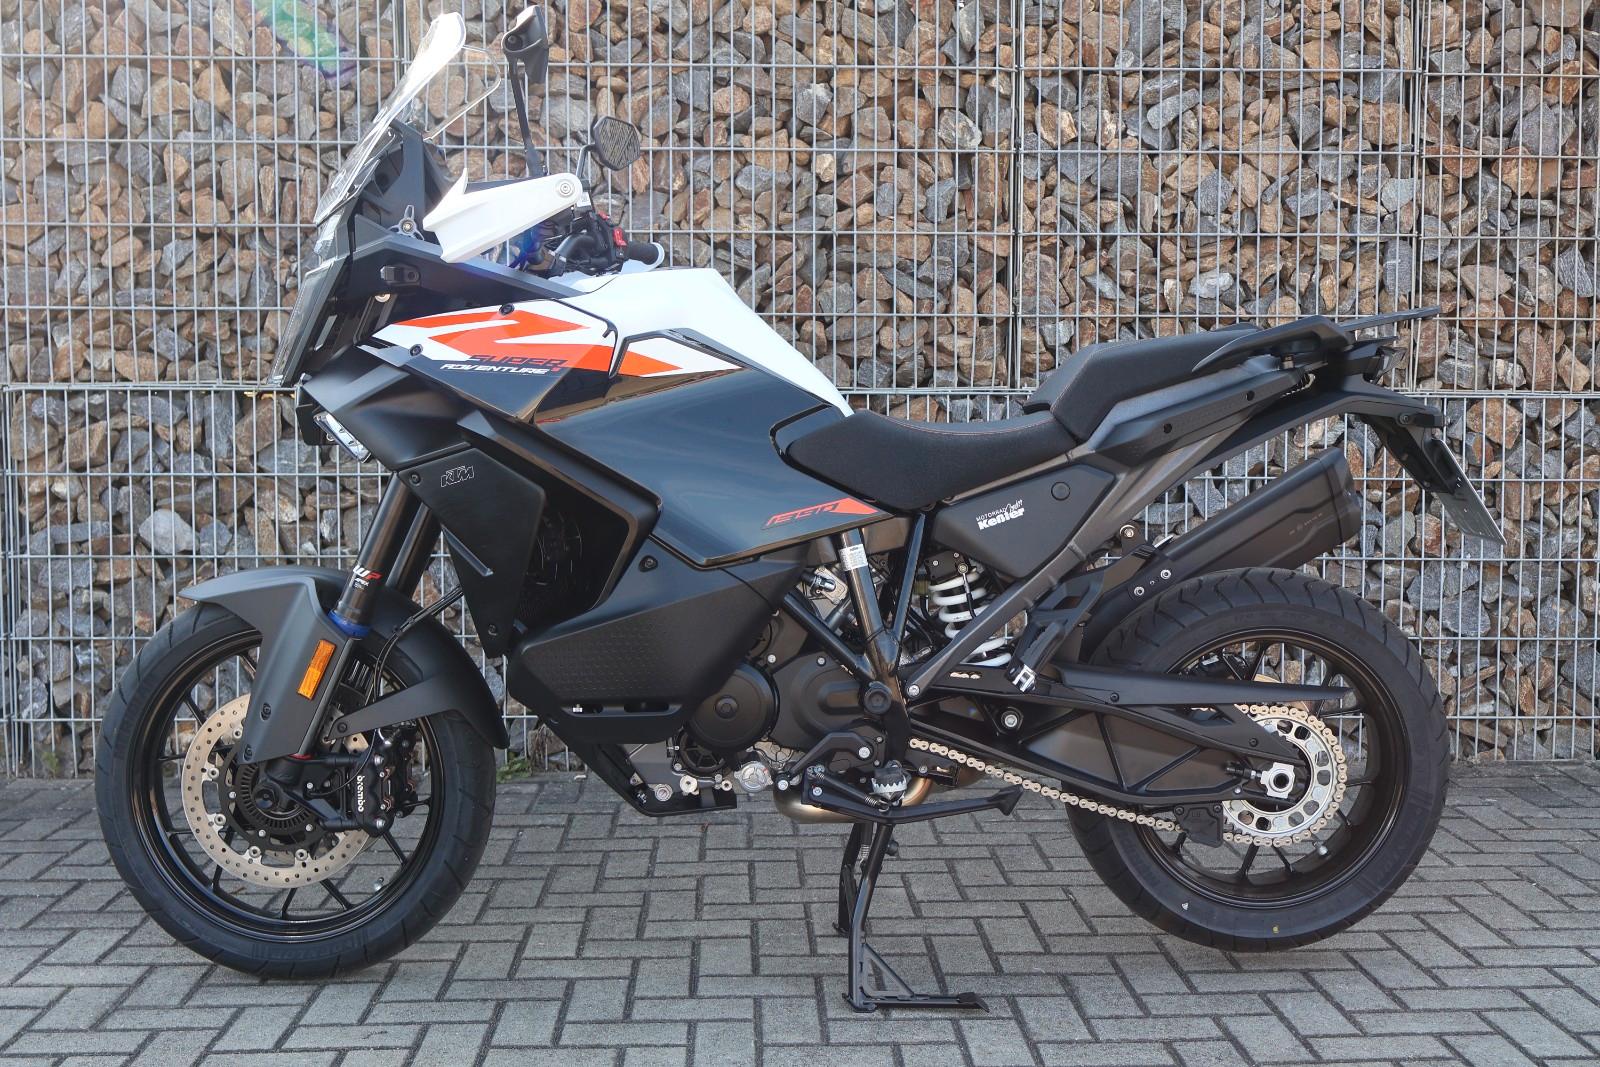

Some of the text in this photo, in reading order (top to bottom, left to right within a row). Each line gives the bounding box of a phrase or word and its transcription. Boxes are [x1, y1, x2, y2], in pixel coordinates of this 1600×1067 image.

[440, 363, 550, 375] ADVENTURE
[440, 465, 475, 488] KTM
[356, 775, 366, 812] brembo
